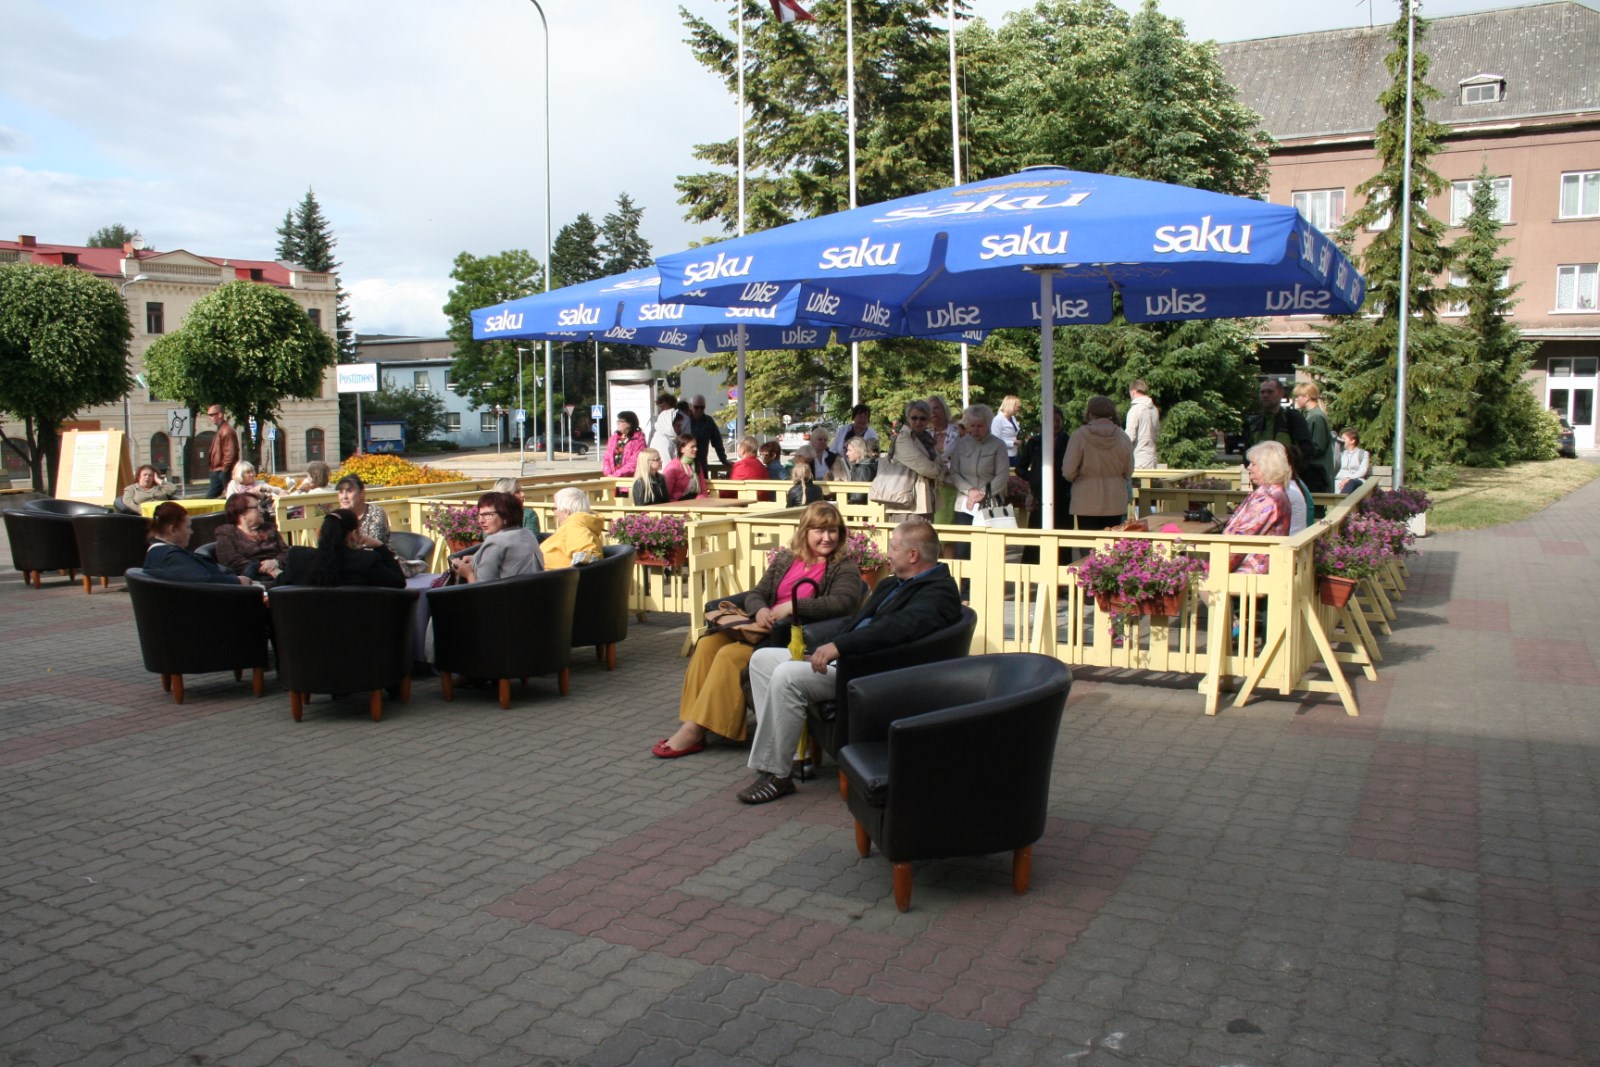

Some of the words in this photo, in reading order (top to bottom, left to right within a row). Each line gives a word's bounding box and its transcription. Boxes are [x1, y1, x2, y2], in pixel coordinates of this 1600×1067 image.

[872, 192, 1092, 223] saku
[980, 224, 1069, 260] saku
[1153, 215, 1252, 255] saku
[819, 236, 900, 270] saku
[682, 252, 754, 287] saku
[484, 309, 524, 333] saku
[557, 303, 600, 326] saku
[638, 303, 685, 321] saku
